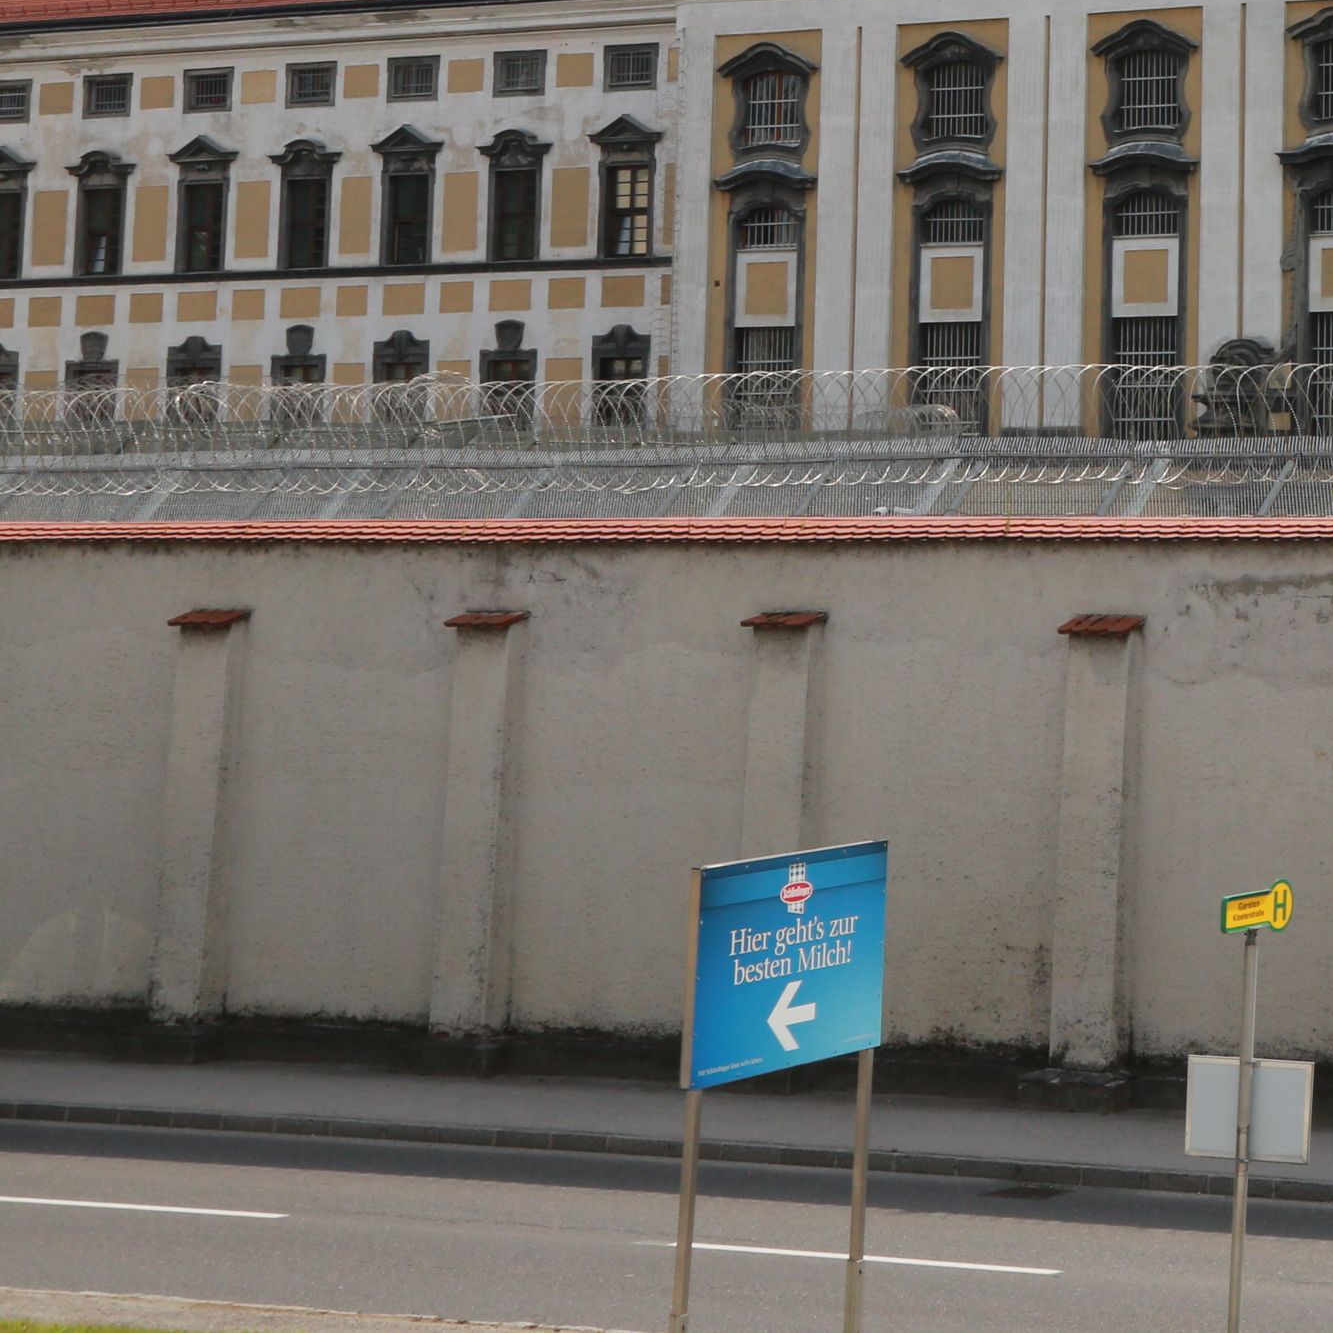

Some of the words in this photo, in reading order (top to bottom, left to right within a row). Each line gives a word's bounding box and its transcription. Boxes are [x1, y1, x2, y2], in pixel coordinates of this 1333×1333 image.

[1273, 889, 1287, 922] H
[729, 927, 771, 956] Hier
[774, 916, 825, 956] geht's
[829, 915, 859, 938] zur
[734, 957, 792, 986] besten
[797, 939, 852, 973] Milch!
